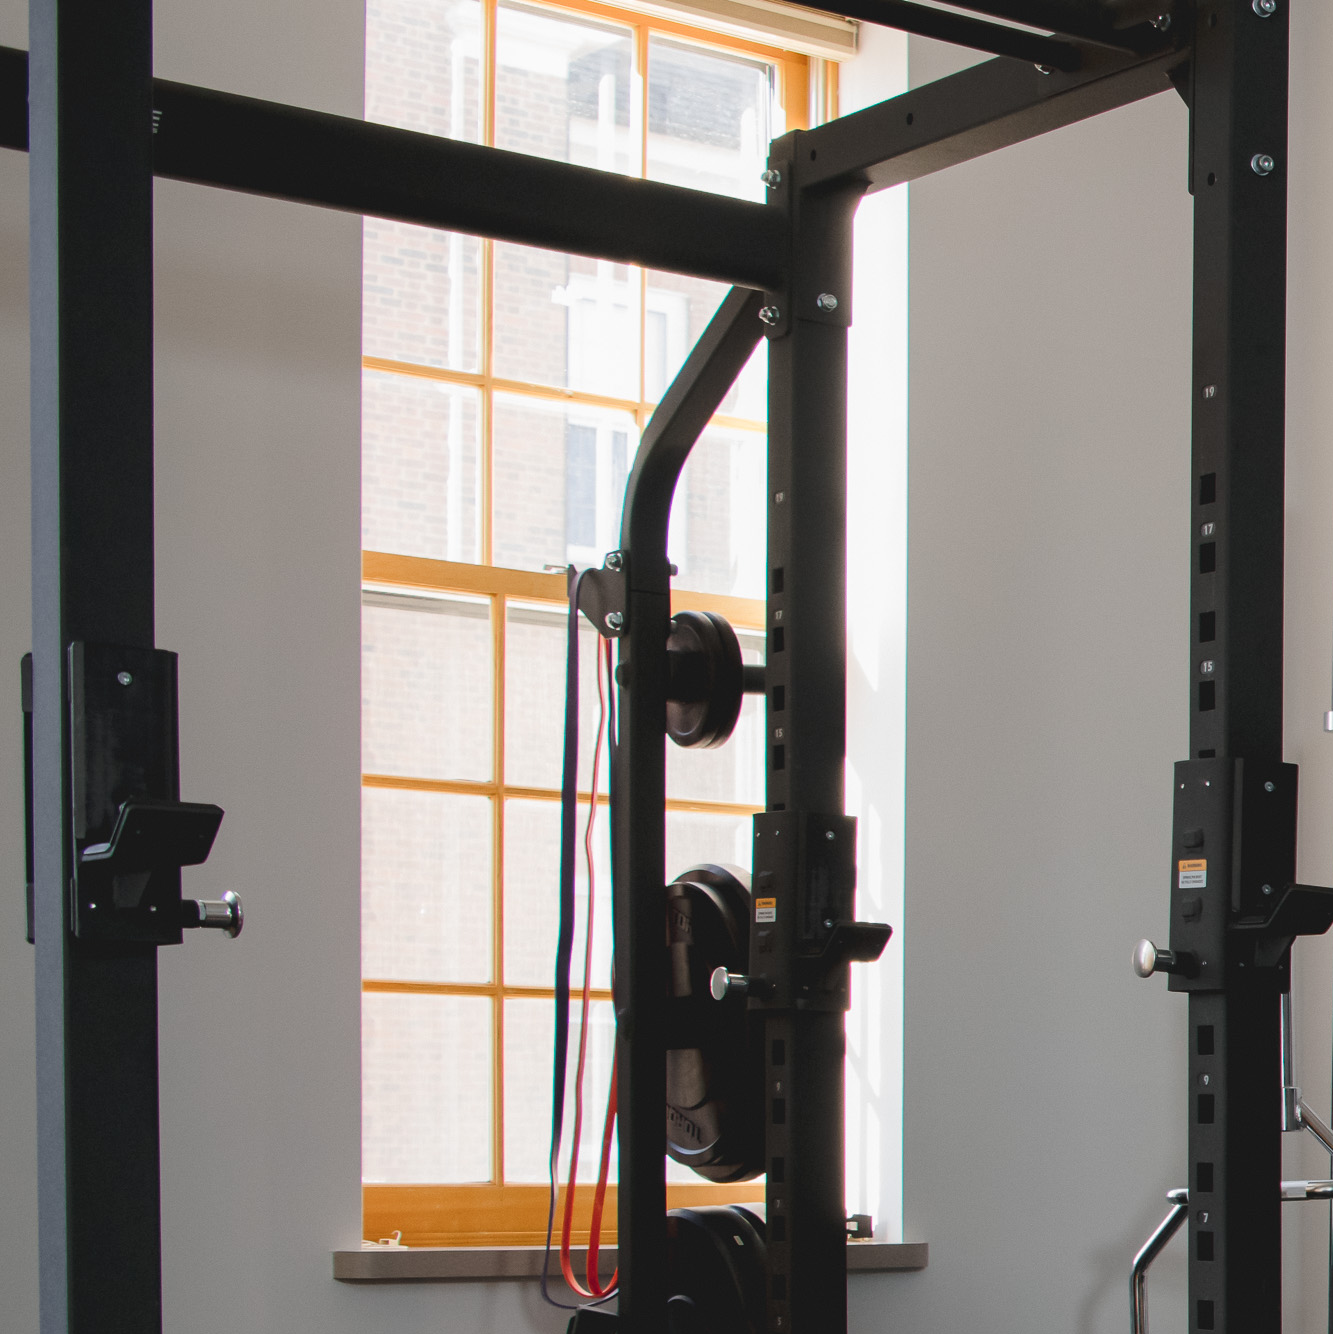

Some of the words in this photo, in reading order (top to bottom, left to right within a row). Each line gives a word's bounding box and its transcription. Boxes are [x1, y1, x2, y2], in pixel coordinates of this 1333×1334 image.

[1205, 386, 1215, 398] 19
[1204, 523, 1213, 535] 17
[775, 610, 783, 620] 17
[1203, 661, 1213, 672] 15
[775, 728, 783, 738] 15
[1203, 1074, 1209, 1085] 9
[1203, 1212, 1209, 1223] 7
